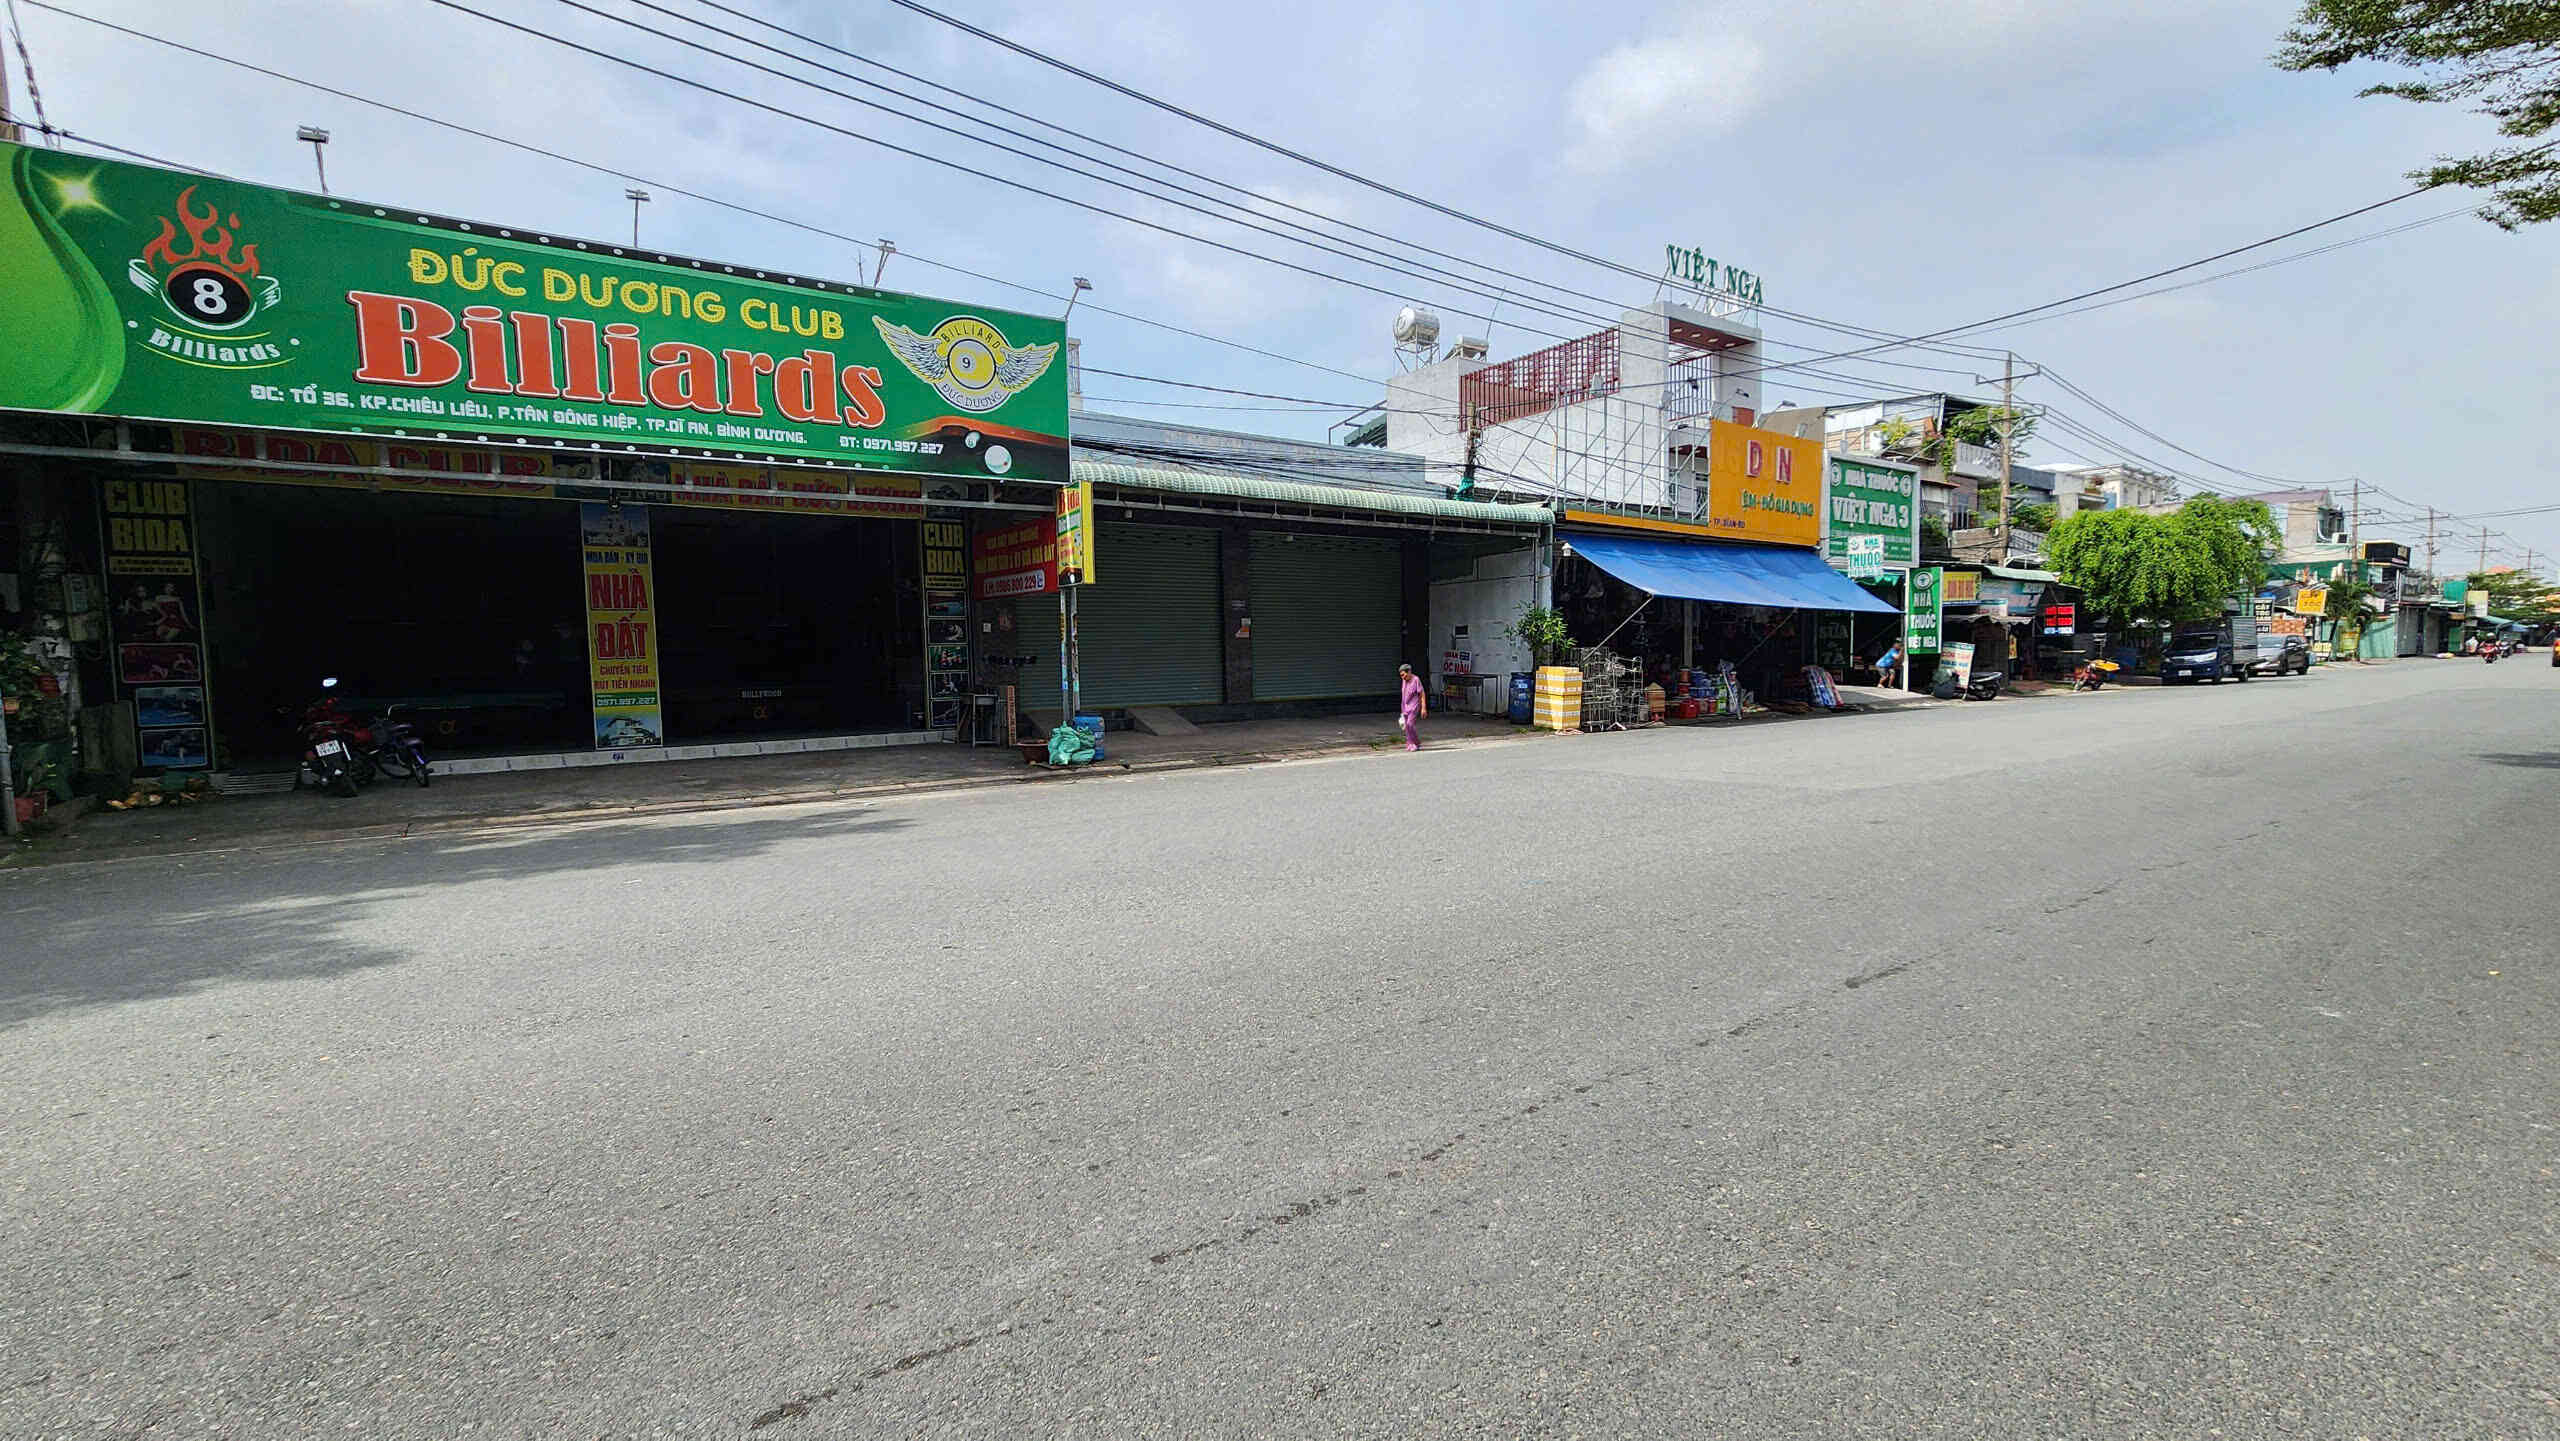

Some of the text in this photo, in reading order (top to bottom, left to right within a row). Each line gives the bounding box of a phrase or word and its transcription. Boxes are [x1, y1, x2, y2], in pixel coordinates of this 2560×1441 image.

[192, 277, 228, 315] 8
[408, 247, 845, 340] ĐỨC DƯƠNG CLUB
[1725, 264, 1764, 305] NGA
[147, 327, 281, 363] Billiards
[939, 323, 1002, 351] BILLIARD
[346, 290, 887, 430] Billiards
[249, 383, 286, 402] ĐC:
[289, 383, 319, 405] TỔ
[552, 408, 599, 427] ĐÔNG
[716, 421, 751, 440] BÌNH
[862, 437, 945, 455] 0971.997.227
[104, 479, 186, 514] CLUB
[1831, 491, 1910, 529] VIỆT NGA 3
[110, 517, 189, 552] BIDA
[924, 522, 965, 547] CLUB
[926, 549, 965, 575] BIDA
[589, 567, 649, 610] NHÀ
[595, 611, 649, 660] ĐẤT
